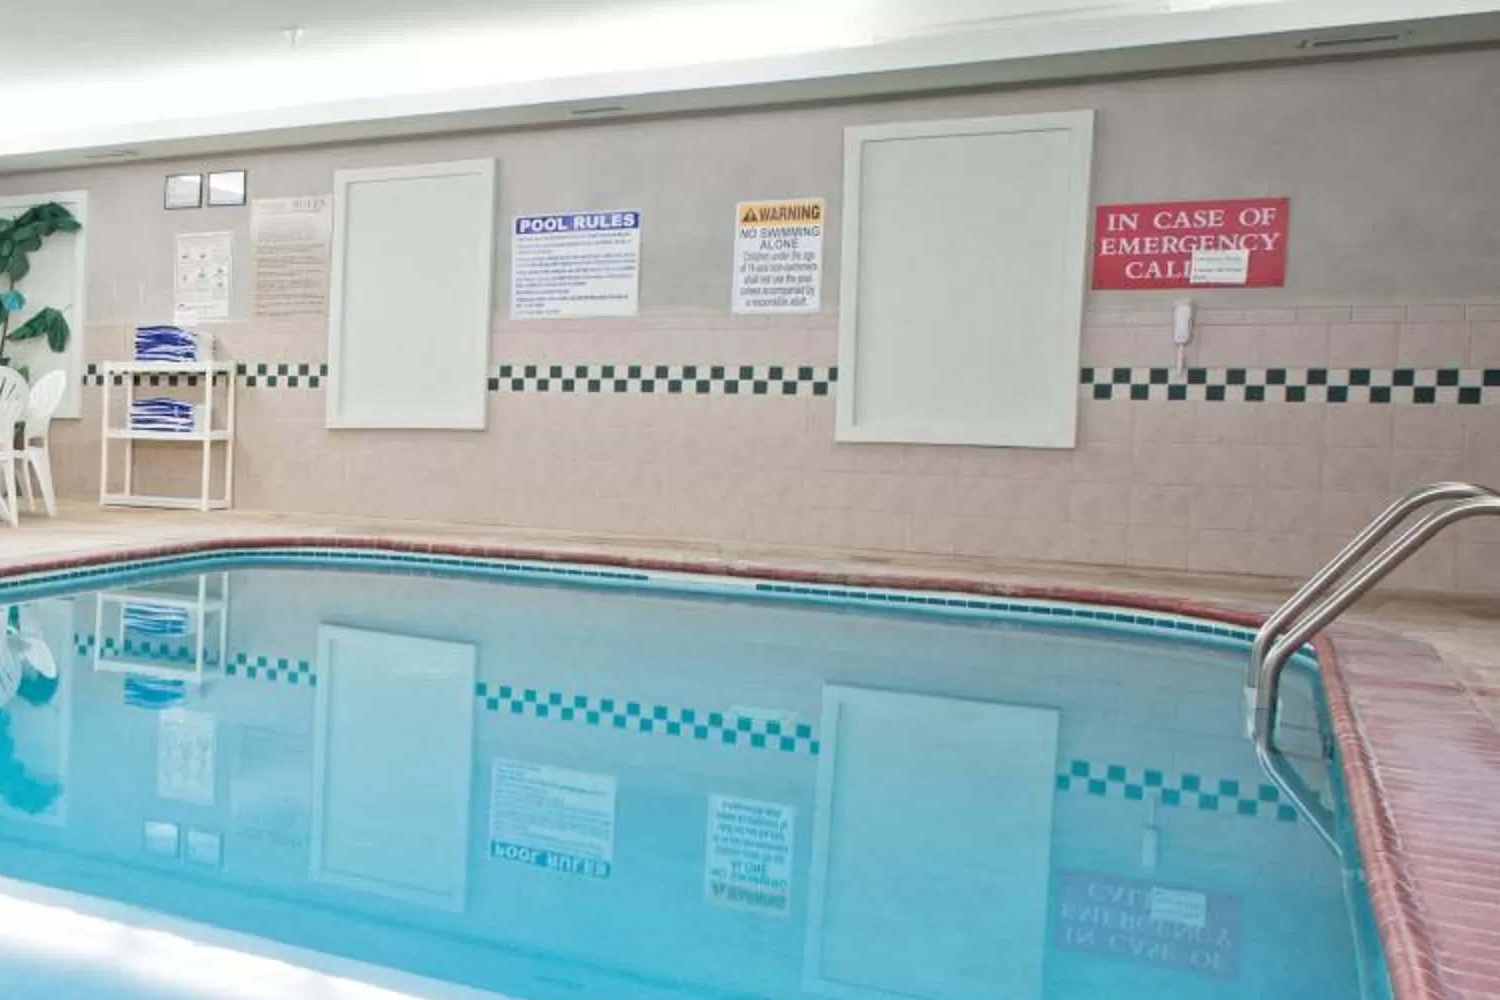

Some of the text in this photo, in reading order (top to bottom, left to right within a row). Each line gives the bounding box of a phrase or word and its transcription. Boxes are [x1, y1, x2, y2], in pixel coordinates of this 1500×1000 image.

[760, 205, 820, 221] WARNING
[1107, 207, 1277, 231] IN CASE OF
[520, 213, 635, 233] POOL RULES
[740, 226, 820, 239] NO SWIMMING
[760, 239, 799, 250] ALONE
[1100, 231, 1280, 256] EMERGENCY
